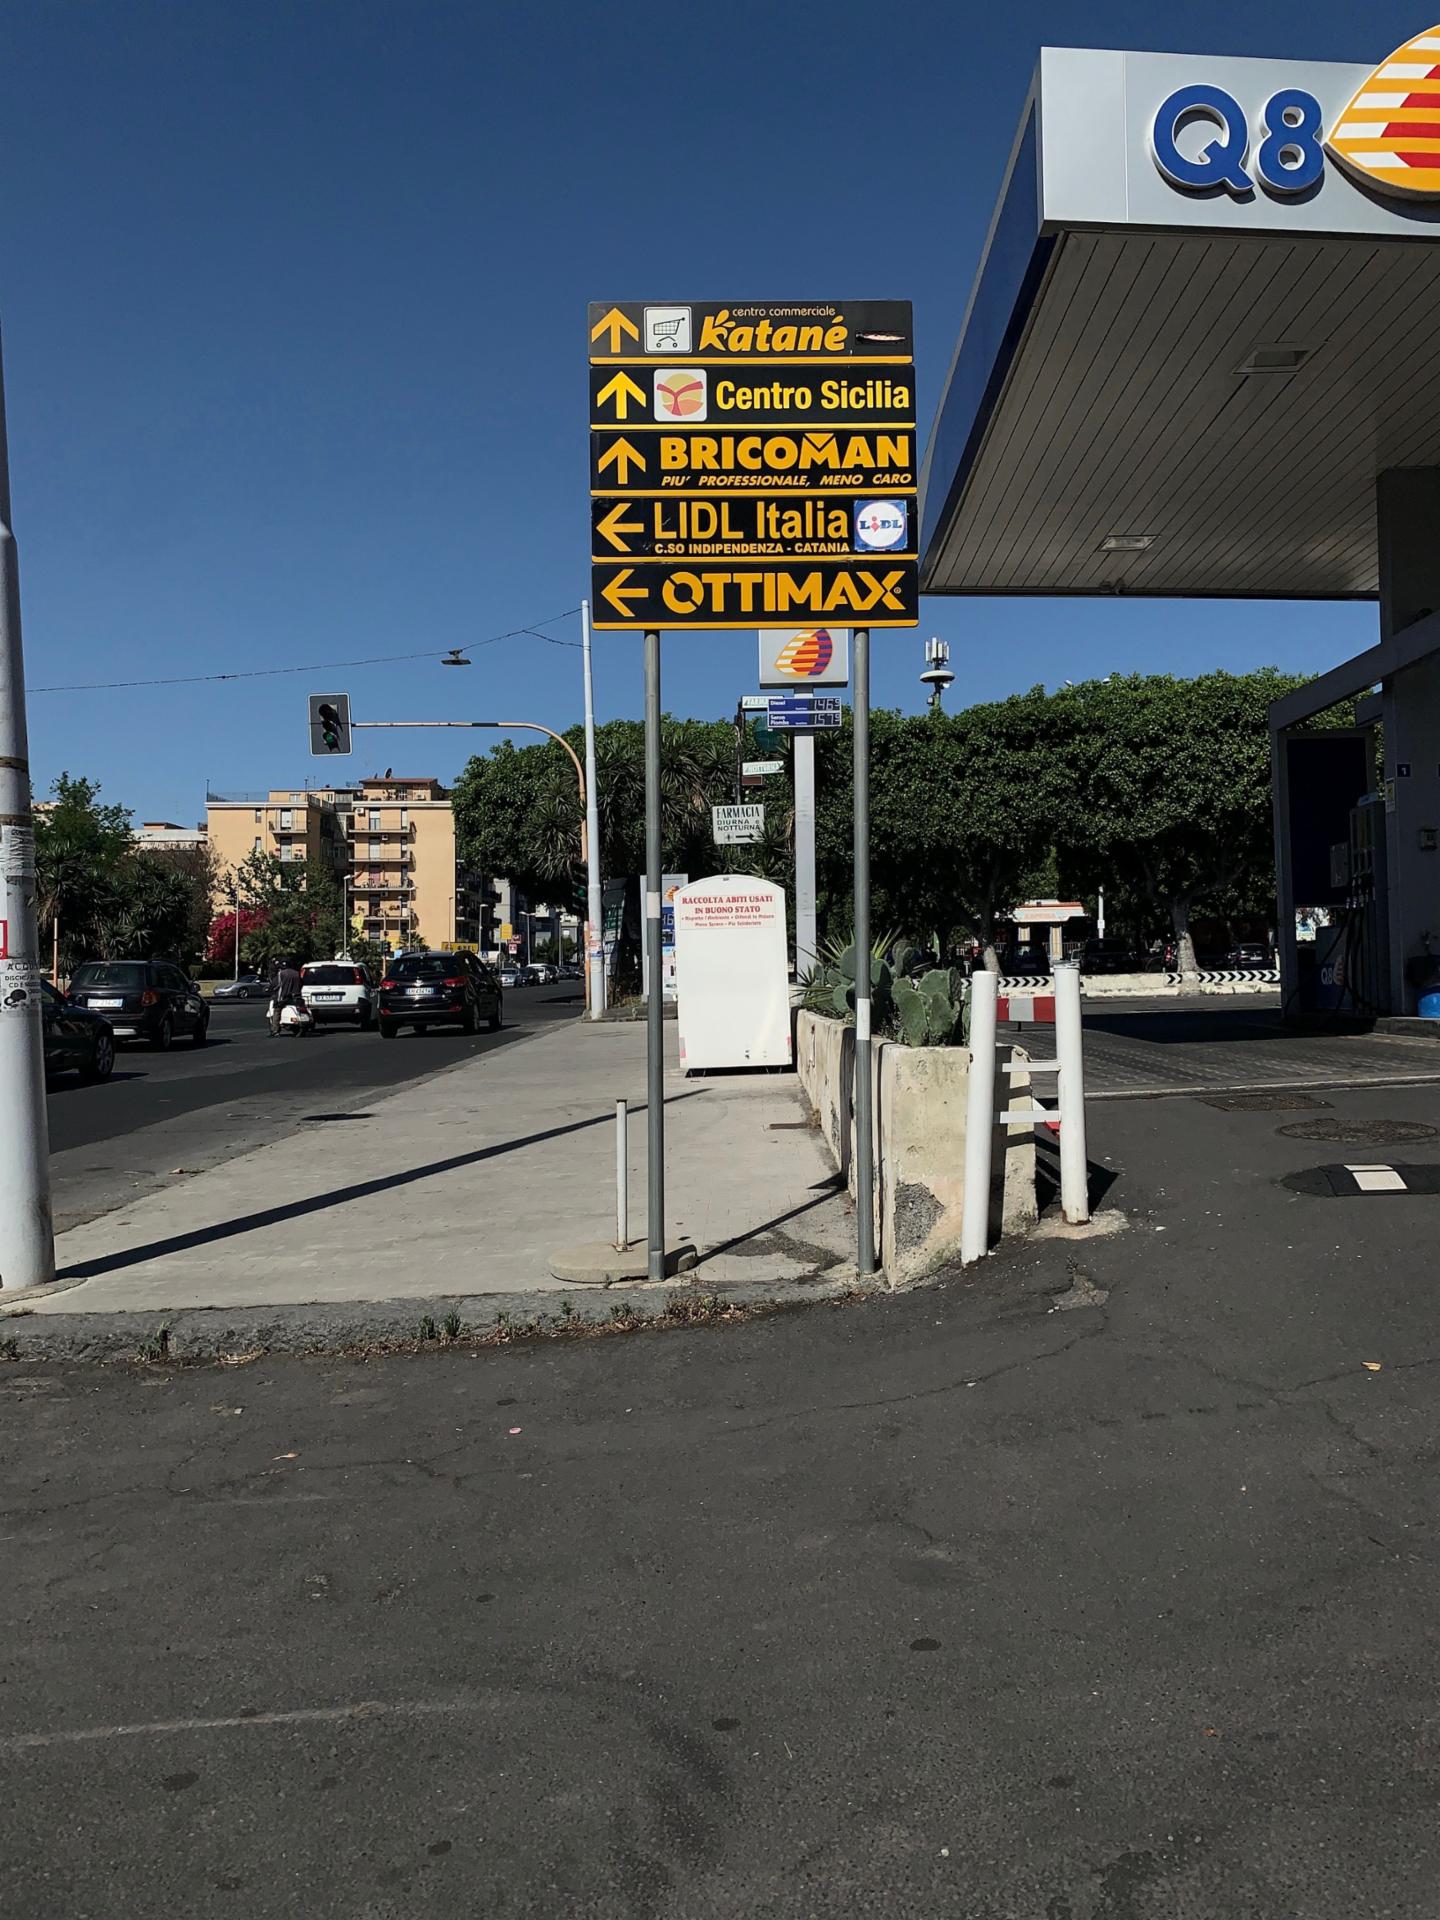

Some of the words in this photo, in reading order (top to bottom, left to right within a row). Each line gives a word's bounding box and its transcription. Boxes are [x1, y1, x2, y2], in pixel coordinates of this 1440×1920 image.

[1152, 82, 1324, 192] Q8
[733, 306, 766, 317] centro
[769, 305, 836, 317] commerciale
[699, 309, 849, 352] Katané
[716, 380, 812, 410] Centro
[821, 379, 910, 409] Sicilia
[660, 433, 909, 470] BRICOMAN
[661, 475, 691, 486] PIU'
[698, 474, 811, 488] PROFESSIONALE,
[820, 474, 863, 485] MENO
[872, 473, 912, 485] CARO
[654, 501, 744, 540] LIDL
[757, 500, 848, 539] Italia
[654, 543, 685, 554] C.SO
[688, 543, 784, 554] INDIPENDENZA
[794, 543, 850, 553] CATANIA
[662, 570, 906, 614] OTTIMAX
[716, 806, 760, 819] FARMACIA
[717, 824, 761, 832] NOTTURNA
[681, 896, 724, 905] RACCOLTA
[725, 896, 747, 904] ABITI
[749, 895, 773, 903] USATI
[704, 906, 733, 914] BUONO
[735, 905, 761, 913] STATO
[1320, 967, 1333, 985] Q8
